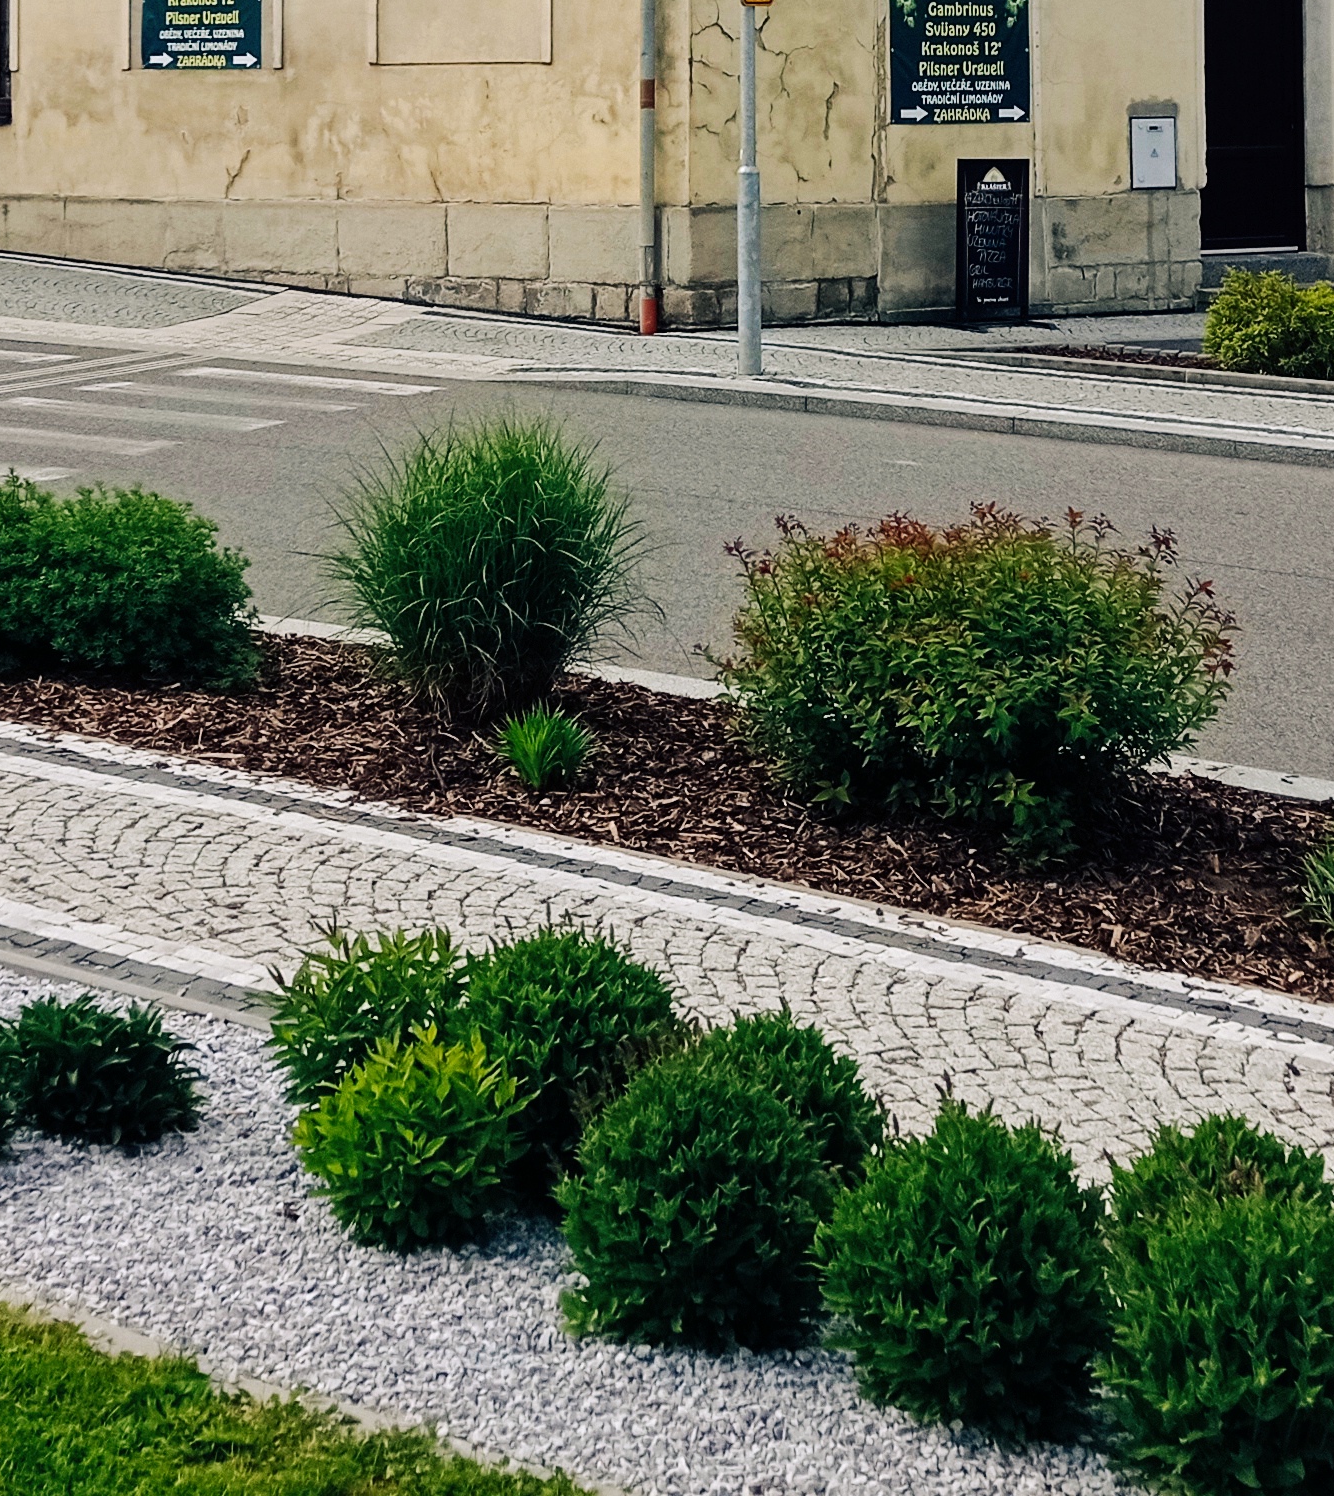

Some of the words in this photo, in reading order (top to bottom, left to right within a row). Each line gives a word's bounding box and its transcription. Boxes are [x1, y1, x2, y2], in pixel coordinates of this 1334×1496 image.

[928, 2, 994, 17] Gambrinus
[166, 11, 201, 25] Pilsner
[973, 22, 996, 36] 450
[921, 41, 979, 56] Krakonoš
[177, 53, 226, 67] ZAHRÁDKA
[919, 61, 960, 76] Pilsner
[941, 79, 973, 92] VEČEŘE,
[975, 81, 1011, 90] UZENINA
[921, 93, 960, 105] TRADIČNÍ
[961, 92, 1003, 104] LIMONÁDY
[934, 106, 990, 121] ZAHRÁDKA
